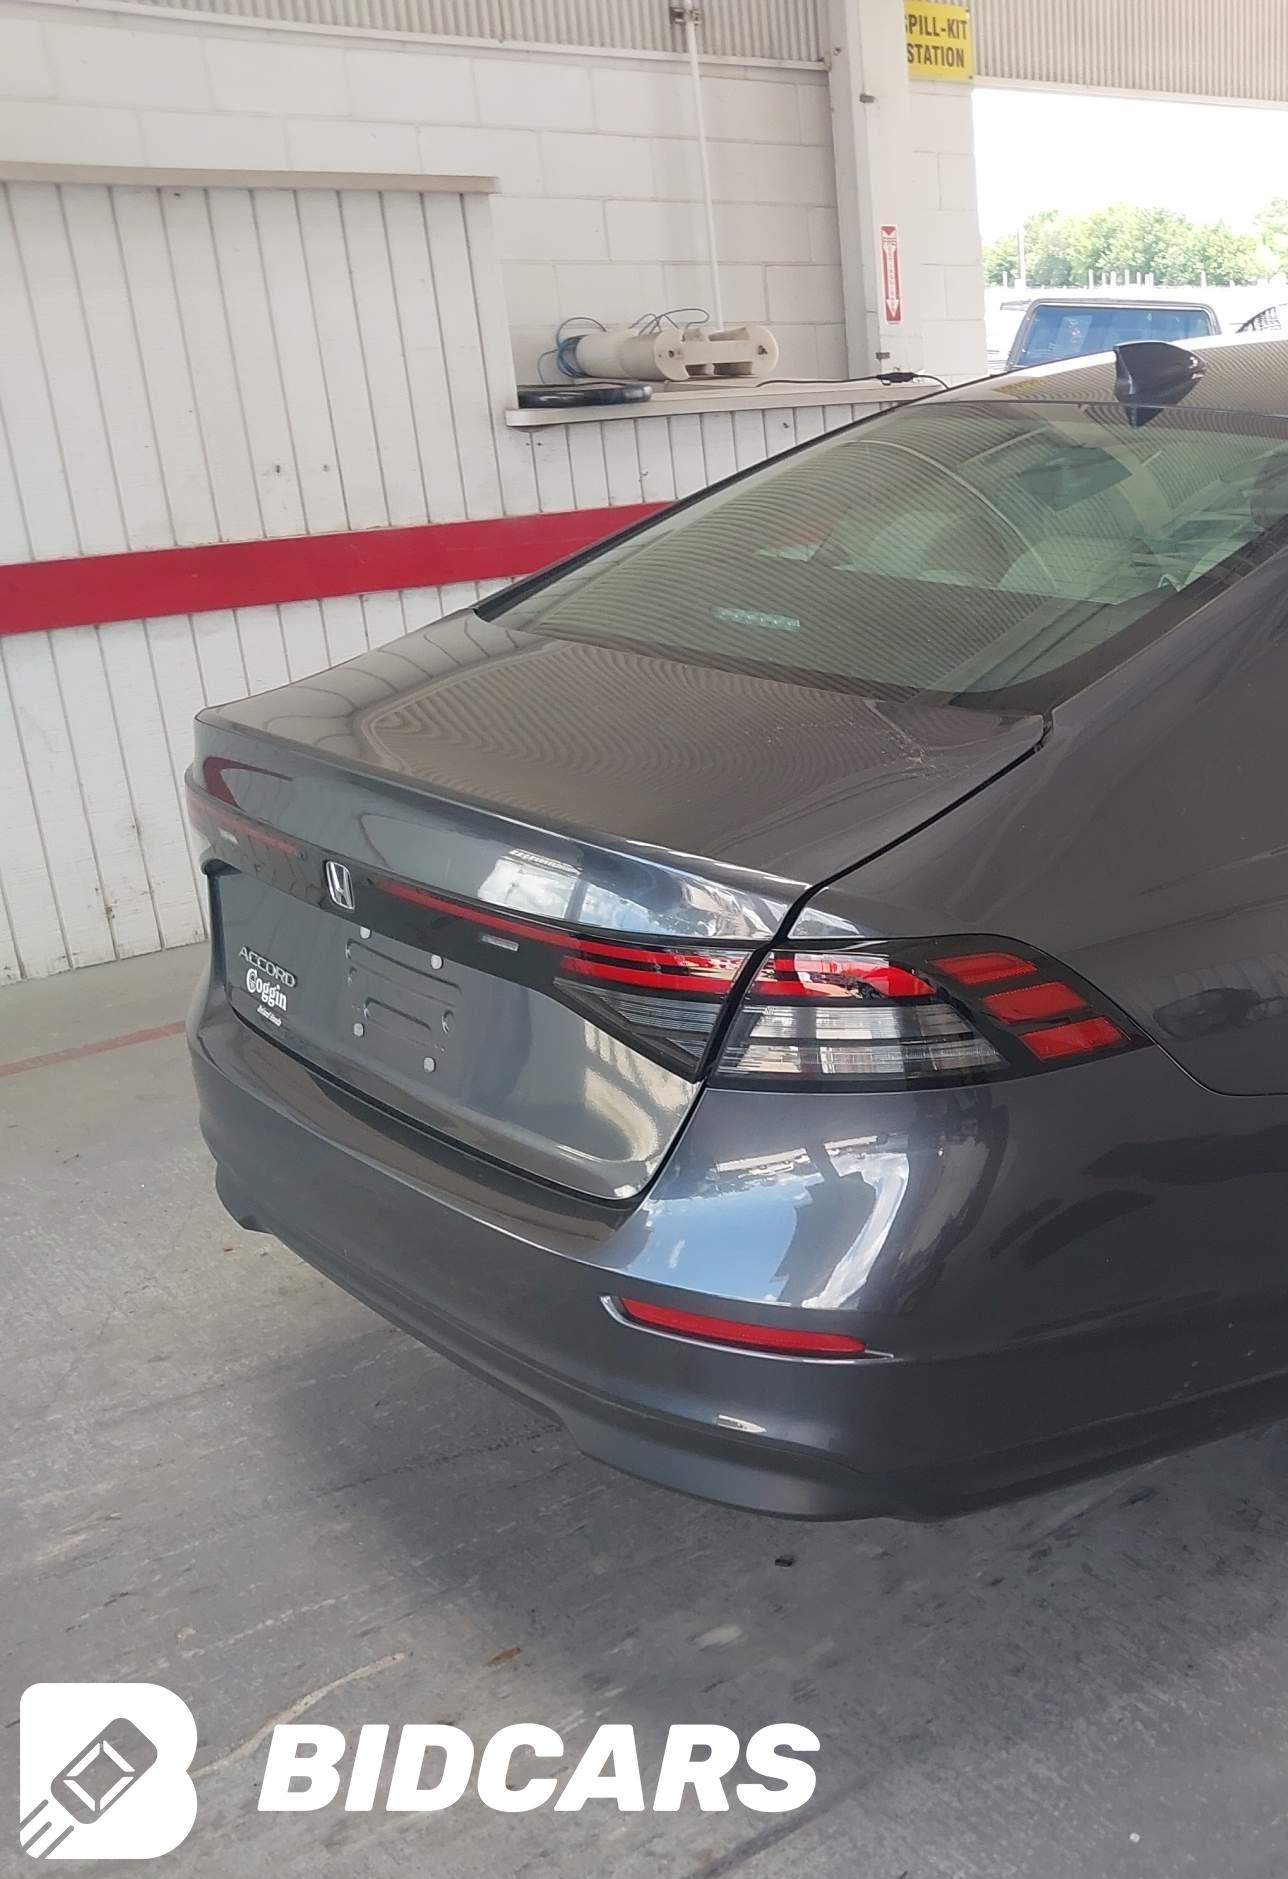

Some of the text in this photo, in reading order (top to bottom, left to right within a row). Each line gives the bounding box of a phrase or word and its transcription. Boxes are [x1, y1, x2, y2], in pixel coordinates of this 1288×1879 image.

[906, 43, 965, 68] STATION
[239, 947, 296, 988] ACCORD
[246, 968, 287, 1011] Coggin
